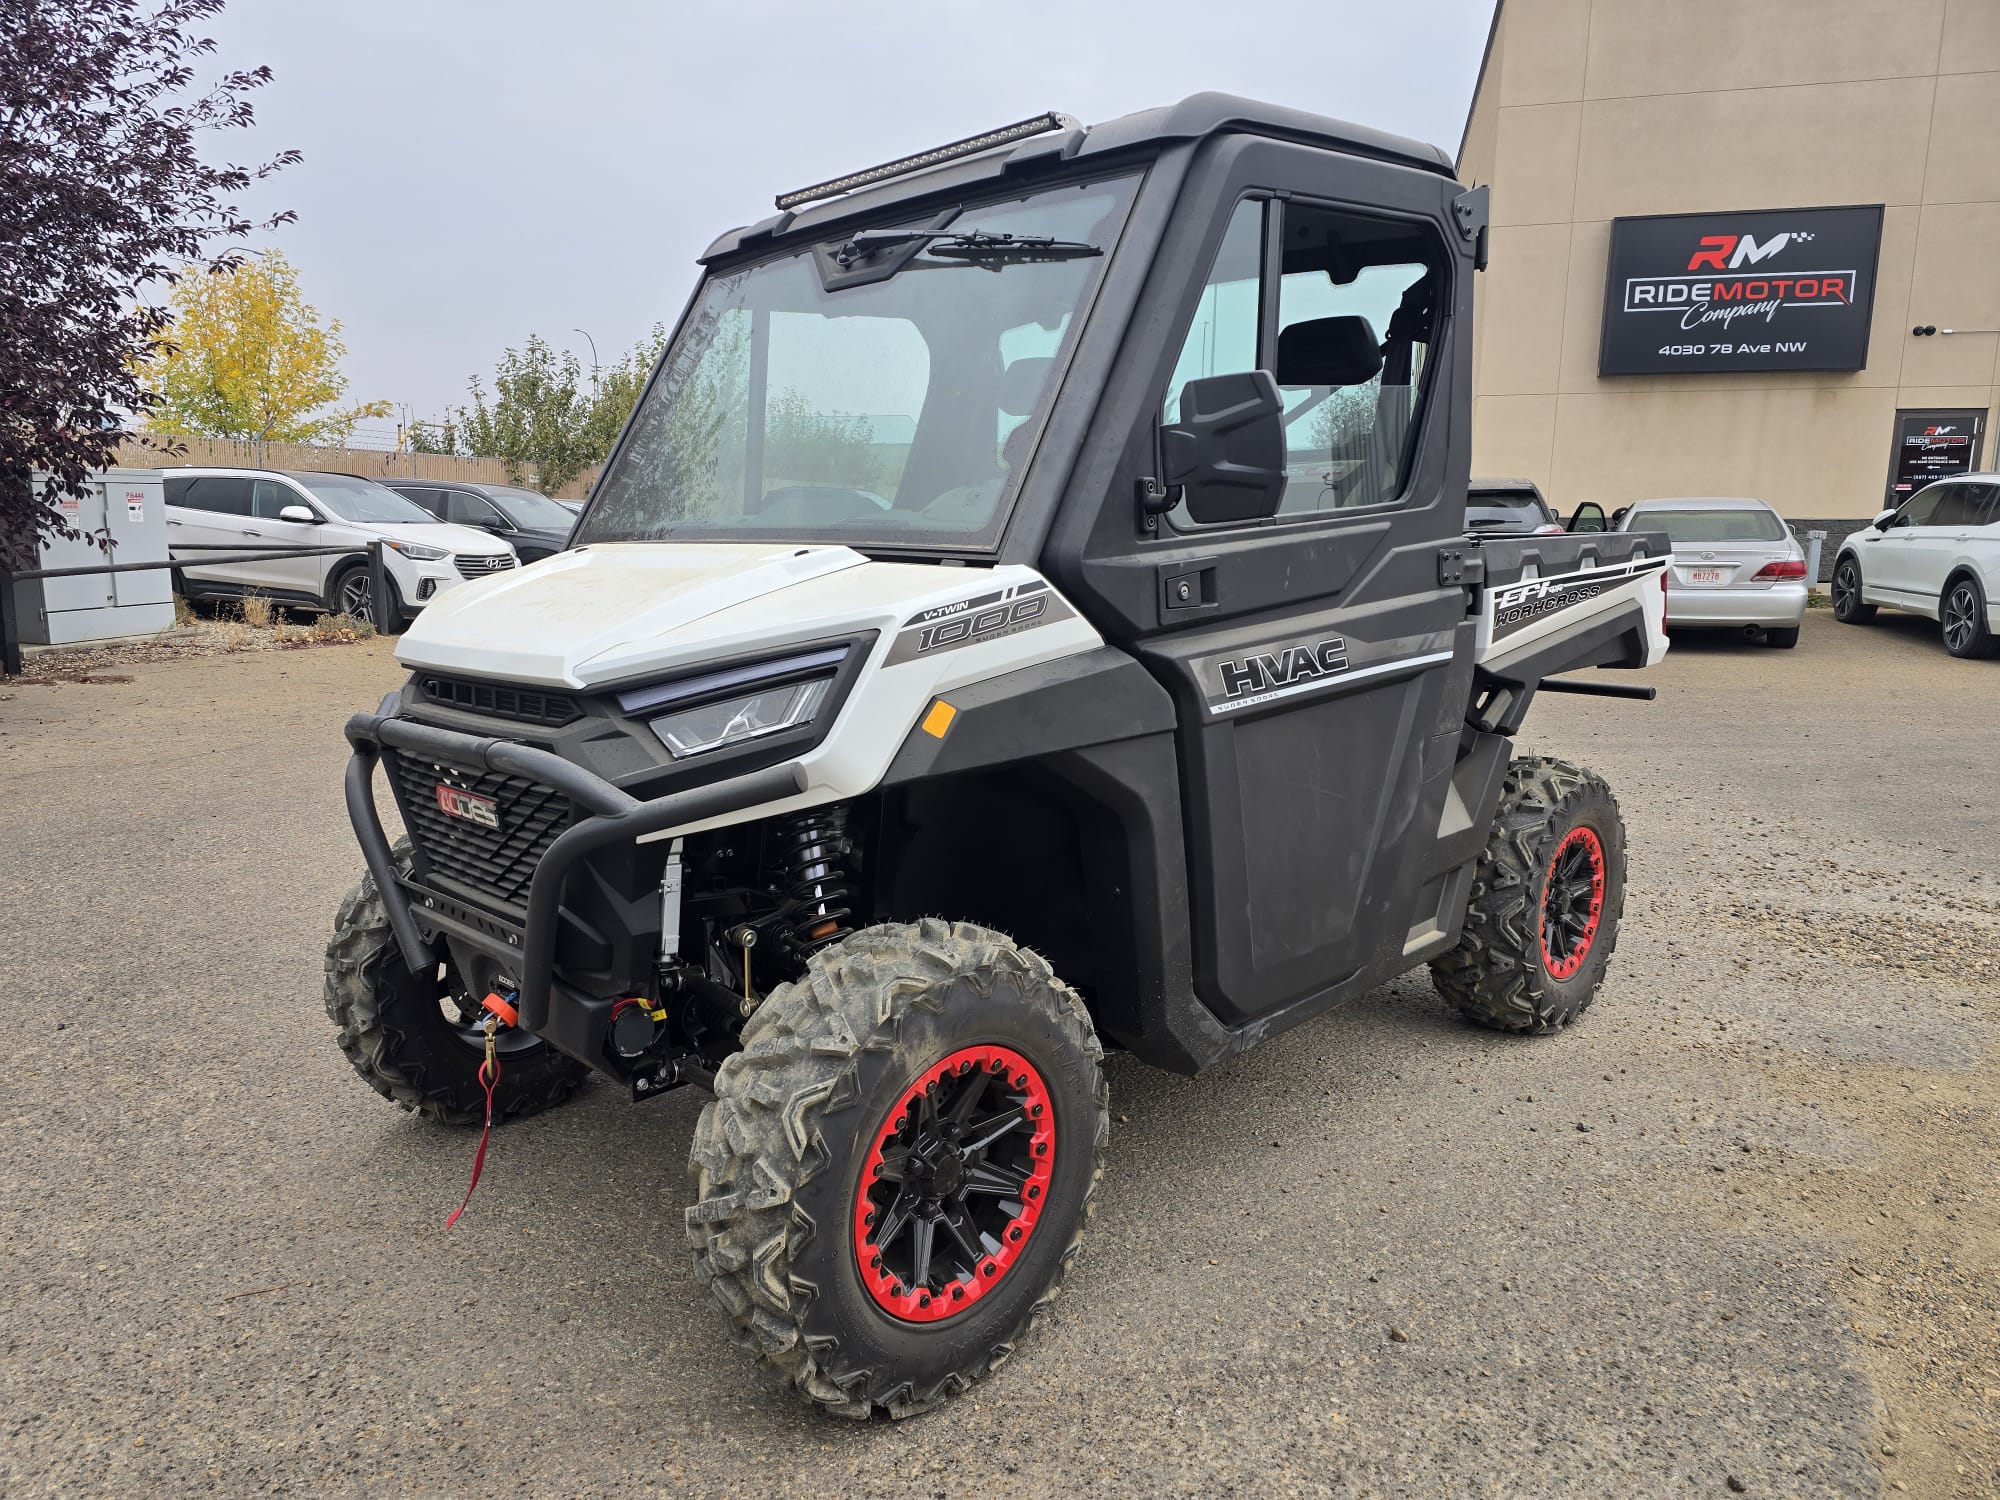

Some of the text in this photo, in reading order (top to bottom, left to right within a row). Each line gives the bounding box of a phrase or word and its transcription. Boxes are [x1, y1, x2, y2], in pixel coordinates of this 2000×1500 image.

[1687, 232, 1791, 270] RM
[1680, 299, 1781, 329] Company
[1658, 342, 1807, 356] 4030 78 Ave NW
[1499, 581, 1550, 609] EFI
[917, 593, 1048, 652] 1000
[924, 601, 969, 620] V-TWIN
[1218, 637, 1349, 698] HVAC
